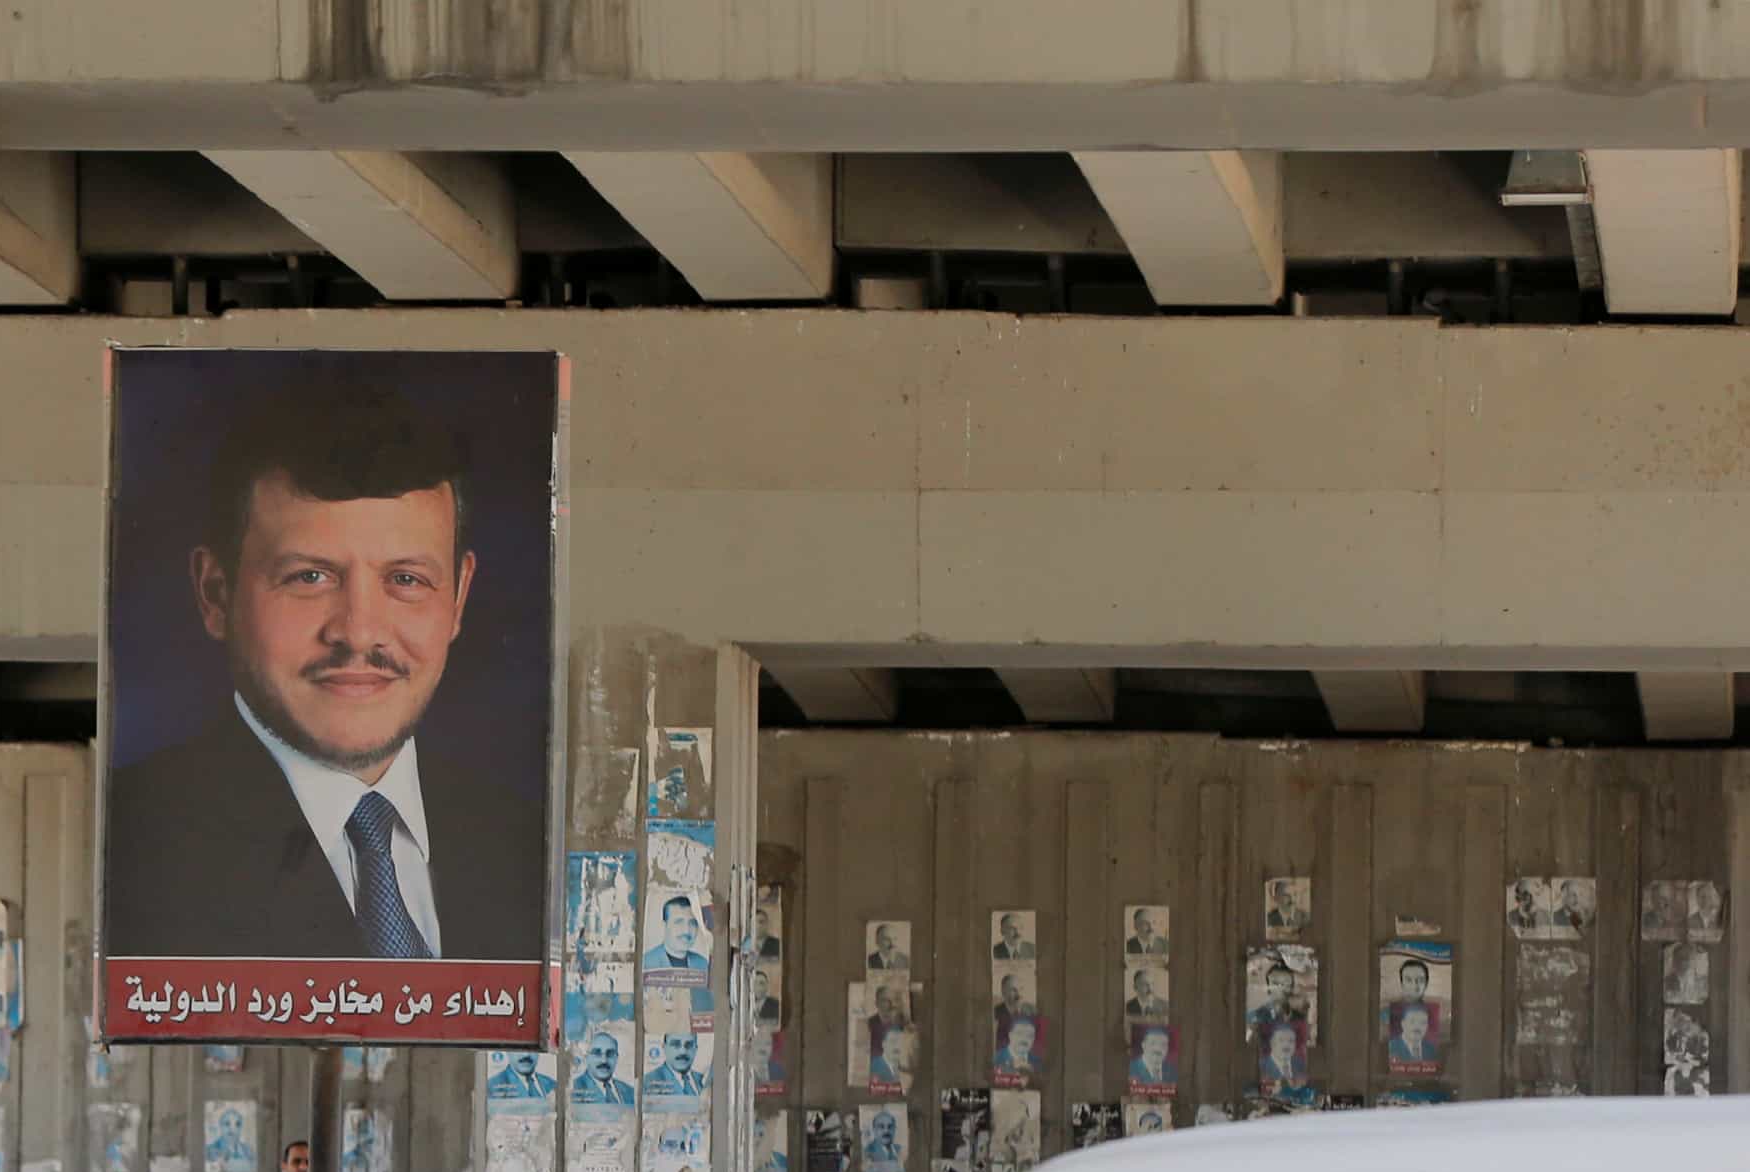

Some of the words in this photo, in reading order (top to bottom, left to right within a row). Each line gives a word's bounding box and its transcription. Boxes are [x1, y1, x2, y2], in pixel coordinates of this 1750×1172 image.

[125, 976, 237, 1023] الدولية
[247, 987, 293, 1022] ورد
[299, 979, 383, 1025] مخابز
[394, 984, 432, 1024] من
[443, 985, 525, 1026] إهداء
